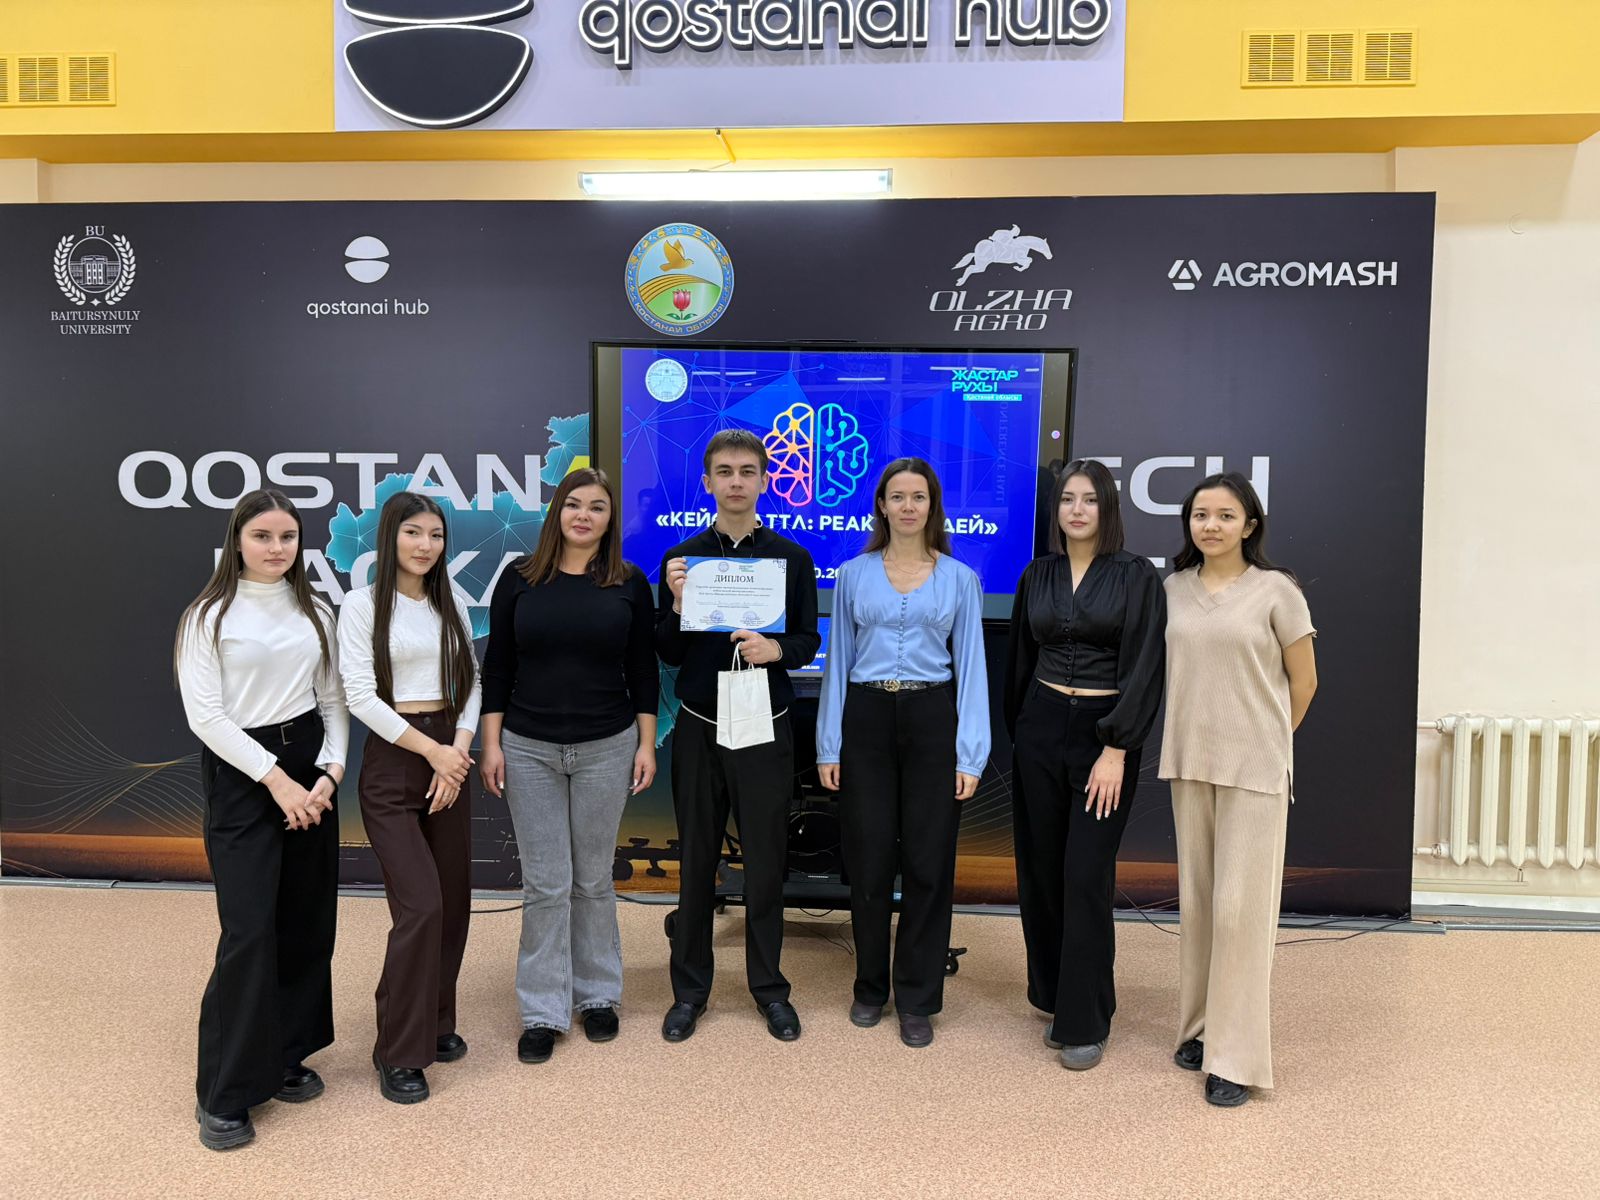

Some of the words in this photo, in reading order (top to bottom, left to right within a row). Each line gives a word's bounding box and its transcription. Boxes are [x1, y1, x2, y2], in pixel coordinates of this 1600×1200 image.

[578, 0, 928, 69] qostanai
[954, 0, 1112, 46] hub
[83, 225, 105, 239] BU
[1213, 261, 1398, 287] AGROMASH
[929, 288, 1073, 312] OLZHA
[306, 299, 388, 319] qostanai
[394, 298, 430, 315] hub
[50, 310, 141, 323] BAITURSYNULY
[953, 313, 1048, 332] AGRO
[60, 324, 132, 336] UNIVERSITY
[952, 369, 1019, 382] ЖАСТАР
[951, 381, 998, 393] РУХЫ
[713, 574, 754, 583] ДИПЛОМ
